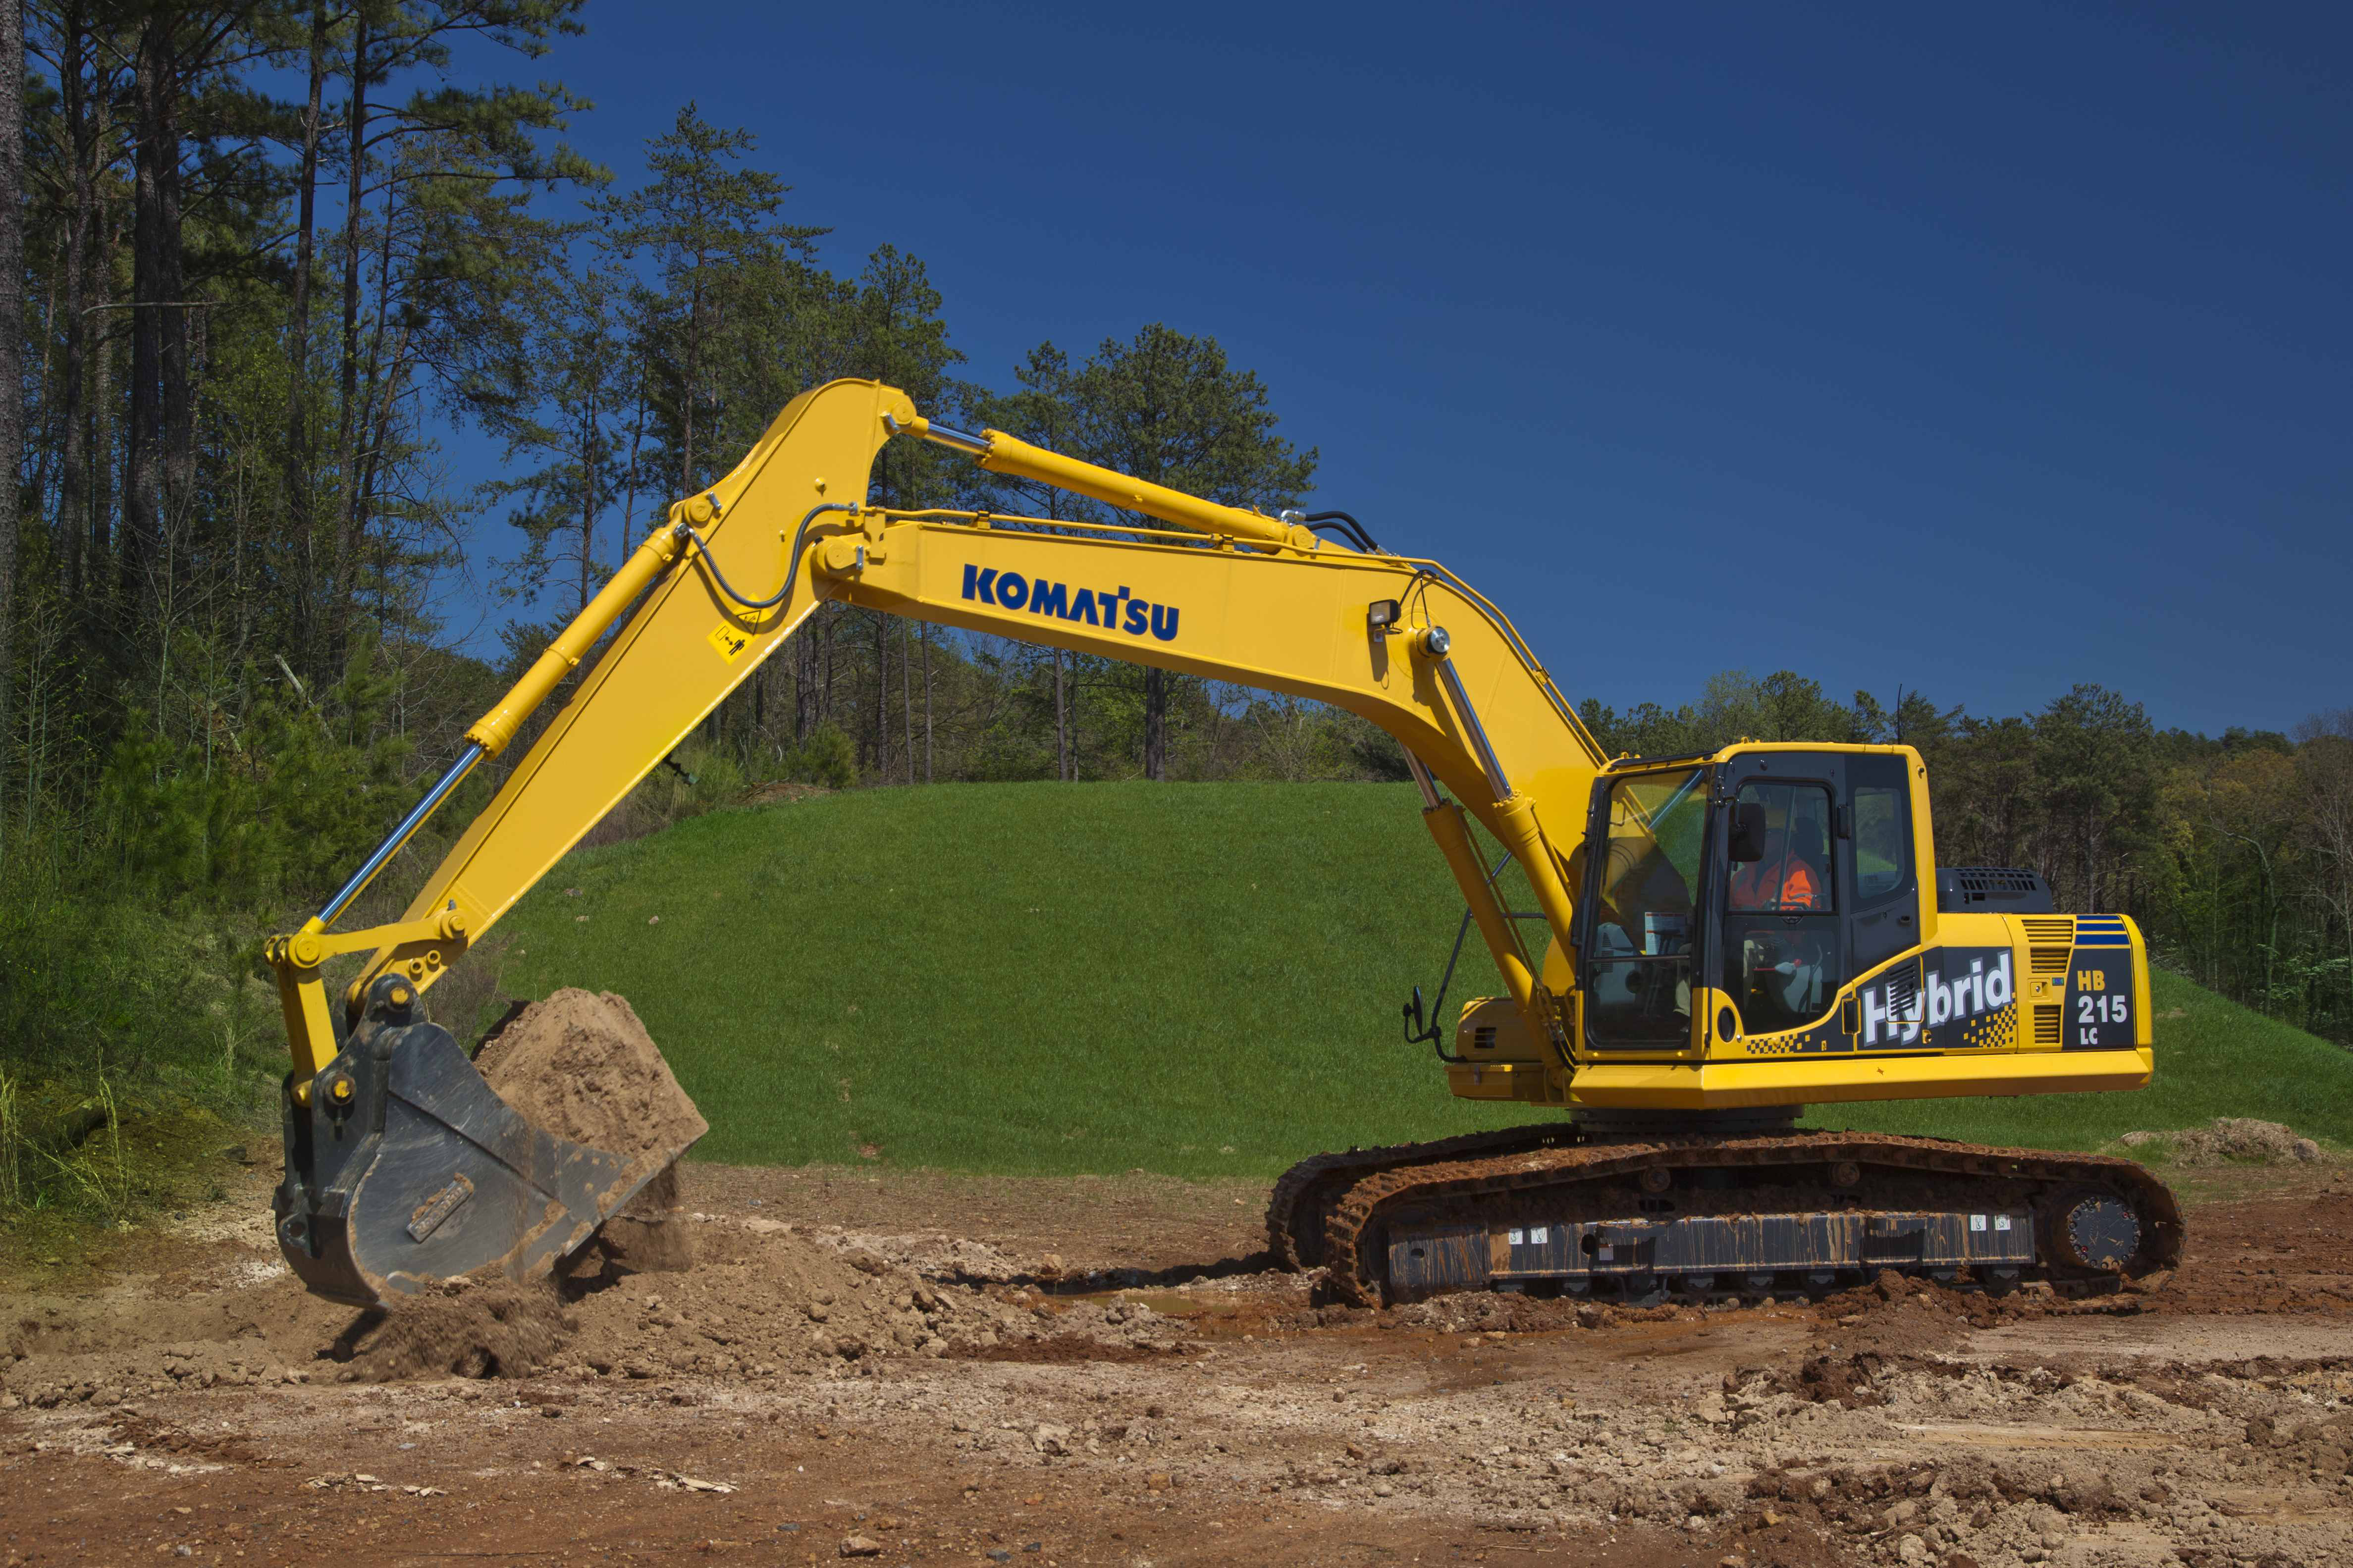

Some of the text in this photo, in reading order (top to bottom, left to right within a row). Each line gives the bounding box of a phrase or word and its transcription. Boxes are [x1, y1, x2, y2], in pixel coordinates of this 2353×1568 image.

[962, 563, 1179, 641] KOMATSU
[2078, 970, 2105, 991] HB
[1863, 950, 2012, 1045] Hybrid
[2078, 995, 2127, 1023] 215
[2081, 1027, 2098, 1045] LC
